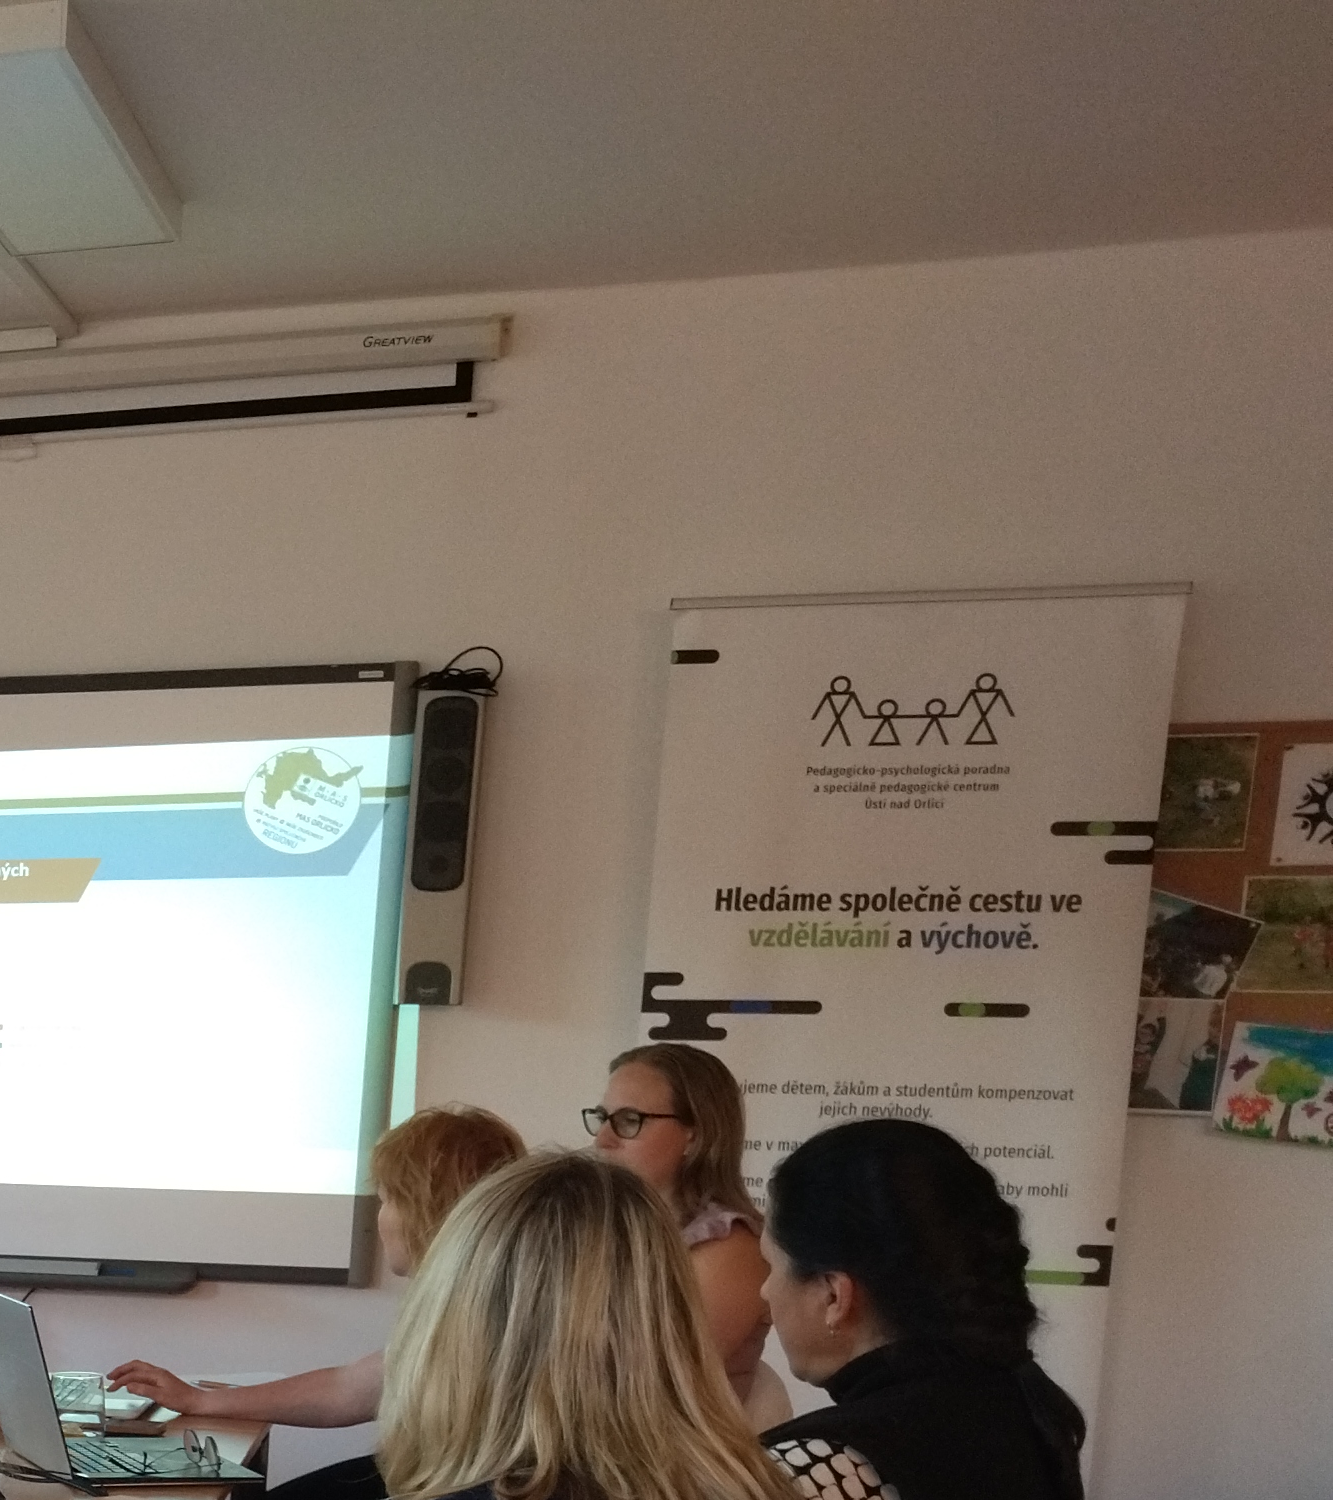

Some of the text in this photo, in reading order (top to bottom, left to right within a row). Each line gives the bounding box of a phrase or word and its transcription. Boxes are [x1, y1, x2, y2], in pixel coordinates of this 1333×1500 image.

[963, 764, 1011, 777] poradna
[813, 784, 820, 793] a
[879, 781, 950, 794] pedagogické
[953, 782, 1000, 792] centrum
[890, 798, 910, 809] nad
[715, 884, 1083, 918] Hledáme společně cestu ve
[748, 920, 1039, 955] vzdělávání a výchově.
[781, 1080, 829, 1097] dětem,
[833, 1081, 878, 1097] žákům
[883, 1086, 892, 1098] a
[896, 1082, 973, 1099] studentům
[978, 1085, 1075, 1102] kompenzovat
[819, 1102, 933, 1120] jejich nevýhody.
[983, 1144, 1054, 1160] potenciál.
[1028, 1183, 1069, 1198] mohli
